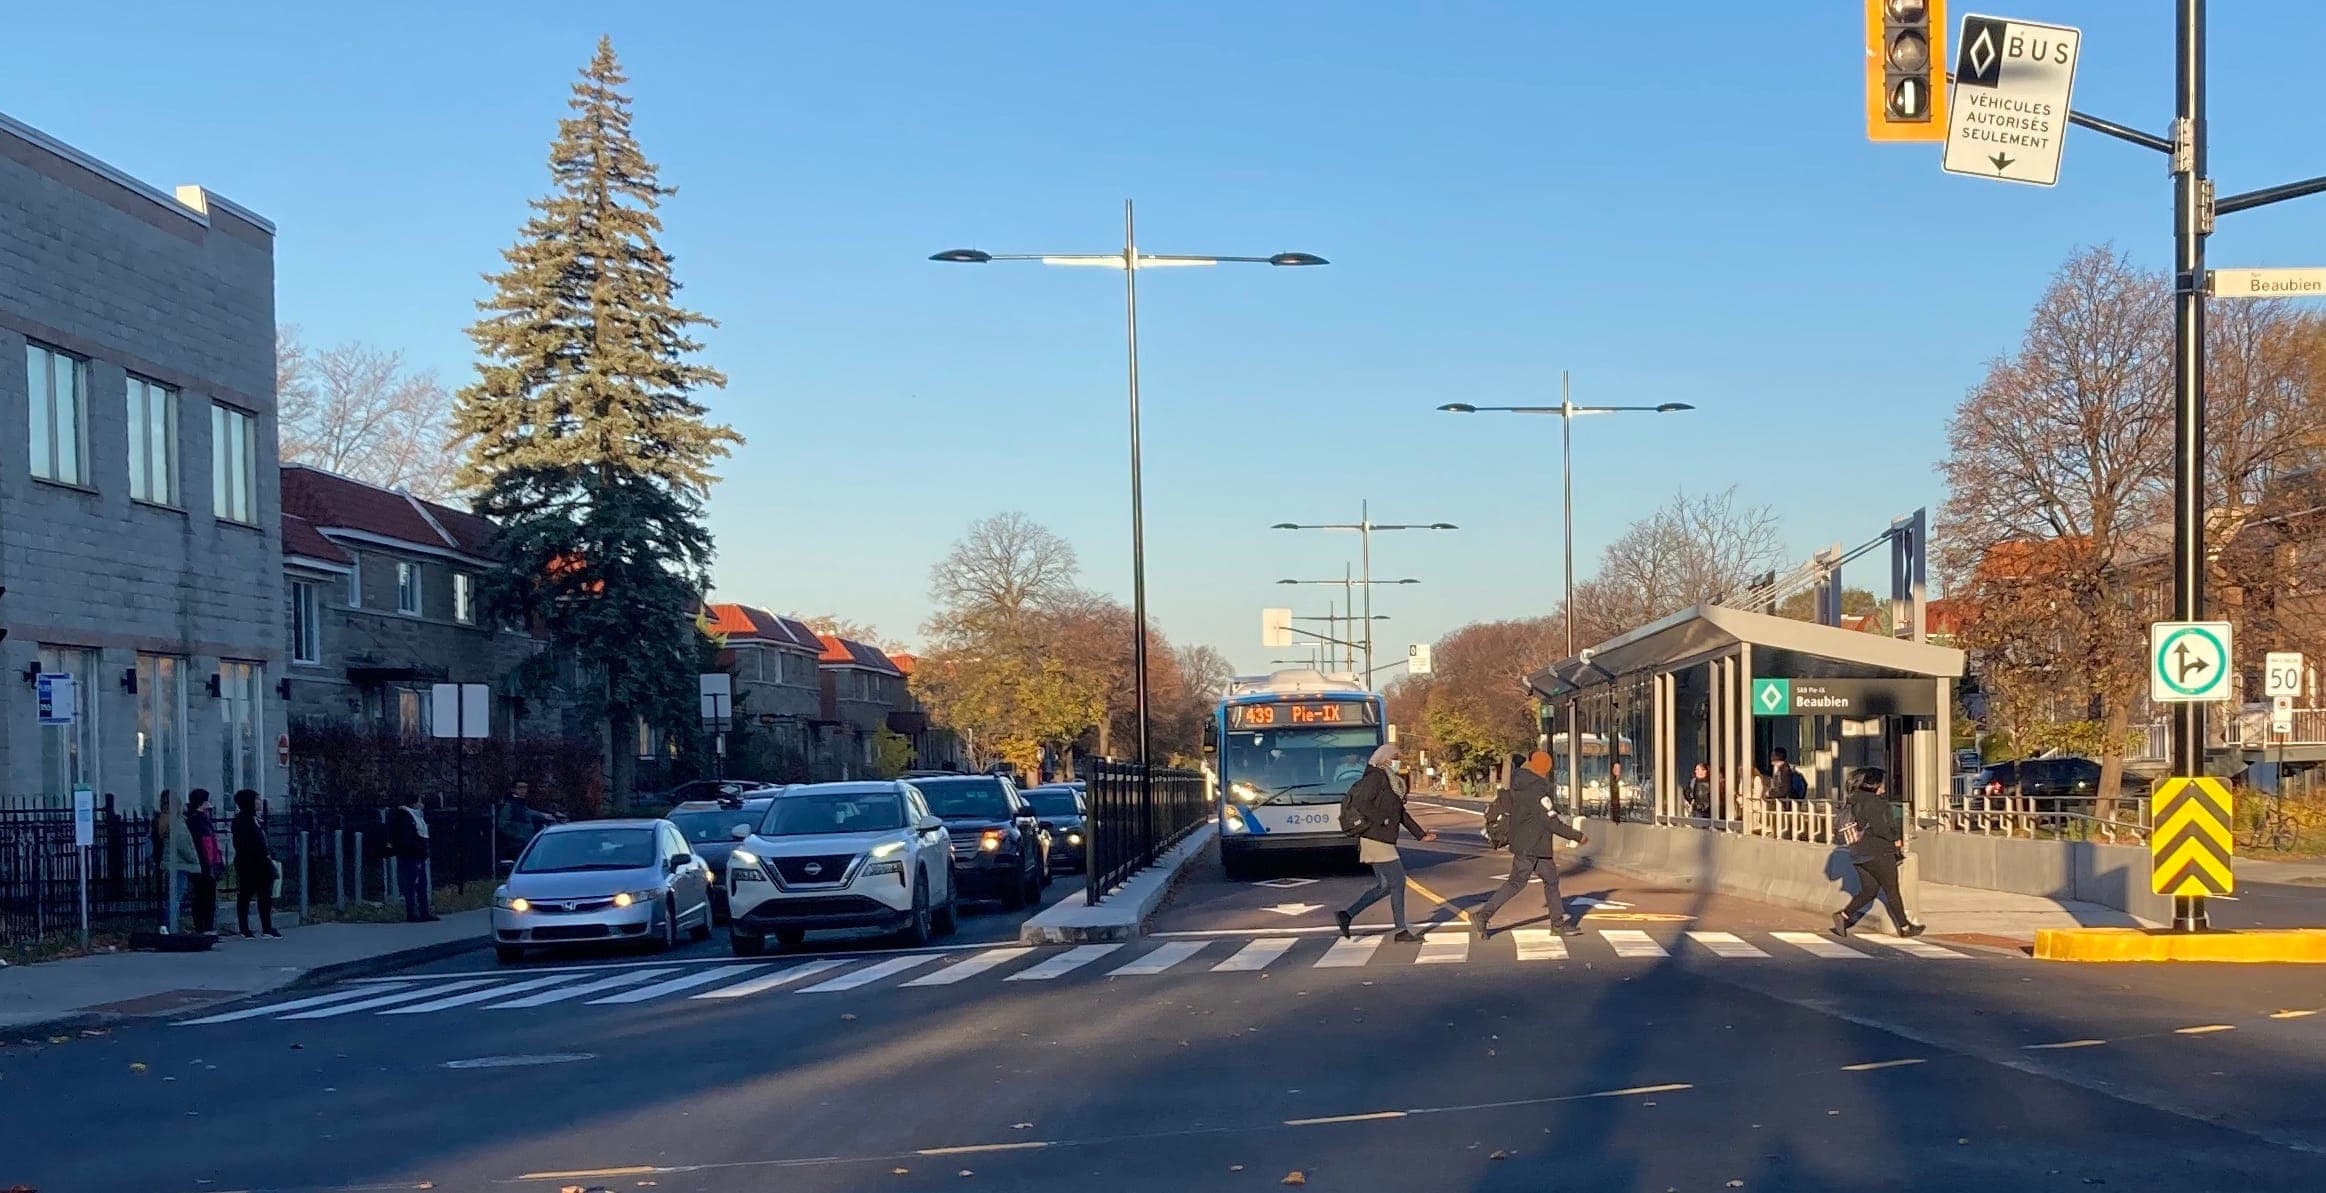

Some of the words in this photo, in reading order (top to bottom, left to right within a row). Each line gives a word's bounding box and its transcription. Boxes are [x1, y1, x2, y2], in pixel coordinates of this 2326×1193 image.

[2008, 36, 2069, 65] BUS
[1969, 92, 2051, 116] VÉHICULES
[1966, 111, 2049, 132] AUTORISÉS
[1962, 127, 2049, 149] SEULEMENT
[2251, 278, 2321, 291] Beaubien
[2271, 668, 2297, 689] 50
[1796, 695, 1849, 707] Beaubien
[1246, 706, 1274, 723] 439
[1292, 704, 1340, 722] Pie-IX
[1286, 813, 1330, 825] 42-009
